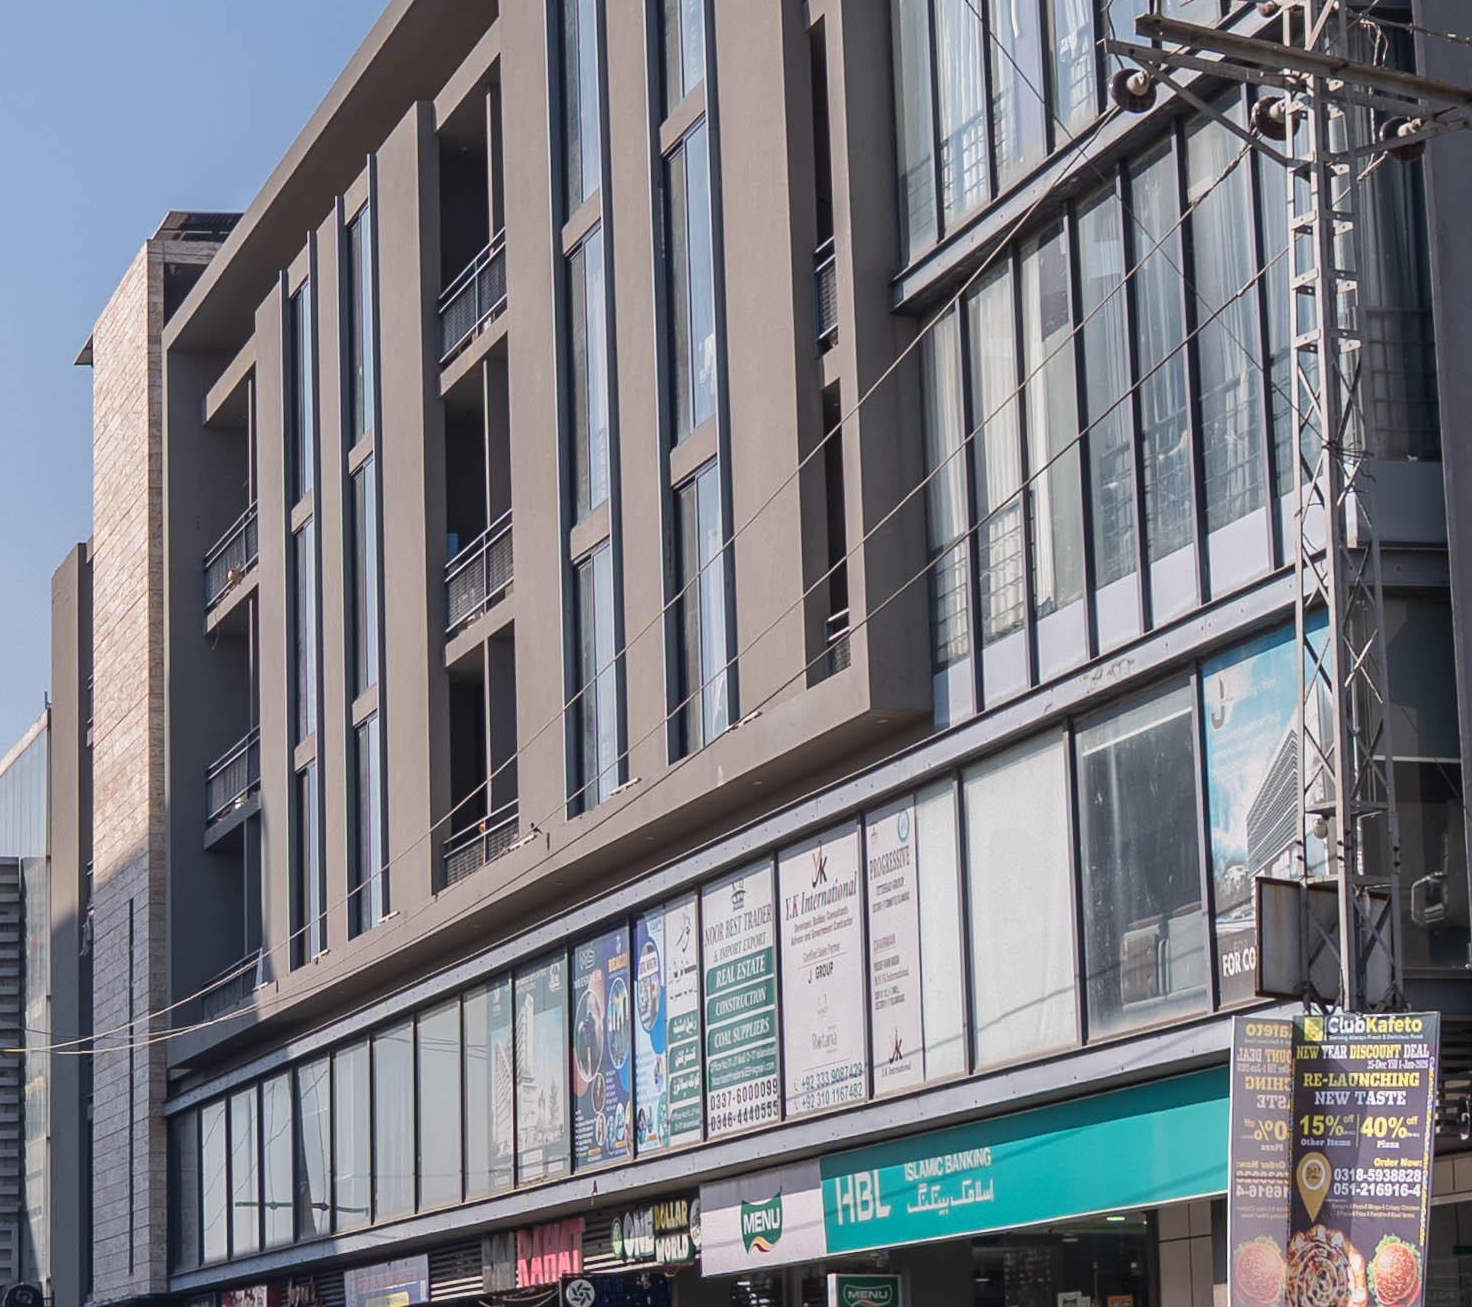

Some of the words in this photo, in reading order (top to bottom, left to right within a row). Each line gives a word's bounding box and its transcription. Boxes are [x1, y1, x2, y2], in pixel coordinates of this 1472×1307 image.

[869, 845, 910, 880] PROGRESSIVE
[801, 870, 858, 916] International
[704, 923, 725, 949] NOOR
[725, 915, 743, 940] BEST
[743, 931, 767, 952] EXPORT
[715, 965, 736, 989] REAL
[736, 954, 766, 980] ESTATE
[815, 961, 834, 980] GROUP
[1222, 951, 1242, 977] FOR
[715, 986, 767, 1017] CONSTRUCTION
[714, 1028, 733, 1049] COAL
[732, 1016, 771, 1044] SUPPLIERS
[1328, 1016, 1423, 1033] ClubKafeto
[1296, 1044, 1320, 1059] NEW
[1321, 1044, 1348, 1059] YEAR
[1349, 1043, 1402, 1060] DISCOUNT
[1402, 1043, 1430, 1059] DEAL
[816, 1071, 830, 1090] 333
[1303, 1072, 1420, 1088] RE-LAUNCHING
[710, 1077, 778, 1111] 0337-6000099
[816, 1089, 830, 1107] 310
[1314, 1091, 1351, 1106] NEW
[1354, 1091, 1407, 1106] TASTE
[710, 1100, 779, 1132] 0346-4440555
[1300, 1115, 1344, 1137] 15%
[1343, 1114, 1355, 1124] off
[1360, 1116, 1408, 1139] 40%
[1405, 1116, 1418, 1126] off
[1300, 1138, 1325, 1147] Other
[1326, 1138, 1351, 1147] Items
[904, 1155, 944, 1182] ISLAMIC
[944, 1146, 992, 1174] BANKING
[1373, 1158, 1399, 1167] Order
[1400, 1158, 1423, 1167] Now:
[1333, 1167, 1422, 1183] 0318-5938828
[835, 1168, 892, 1225] HBL
[1333, 1182, 1421, 1198] 051-216916-4
[654, 1199, 688, 1229] DOLLAR
[743, 1206, 780, 1235] MENU
[623, 1206, 655, 1260] ONE
[656, 1233, 690, 1263] WORLD
[847, 1291, 888, 1300] MENU
